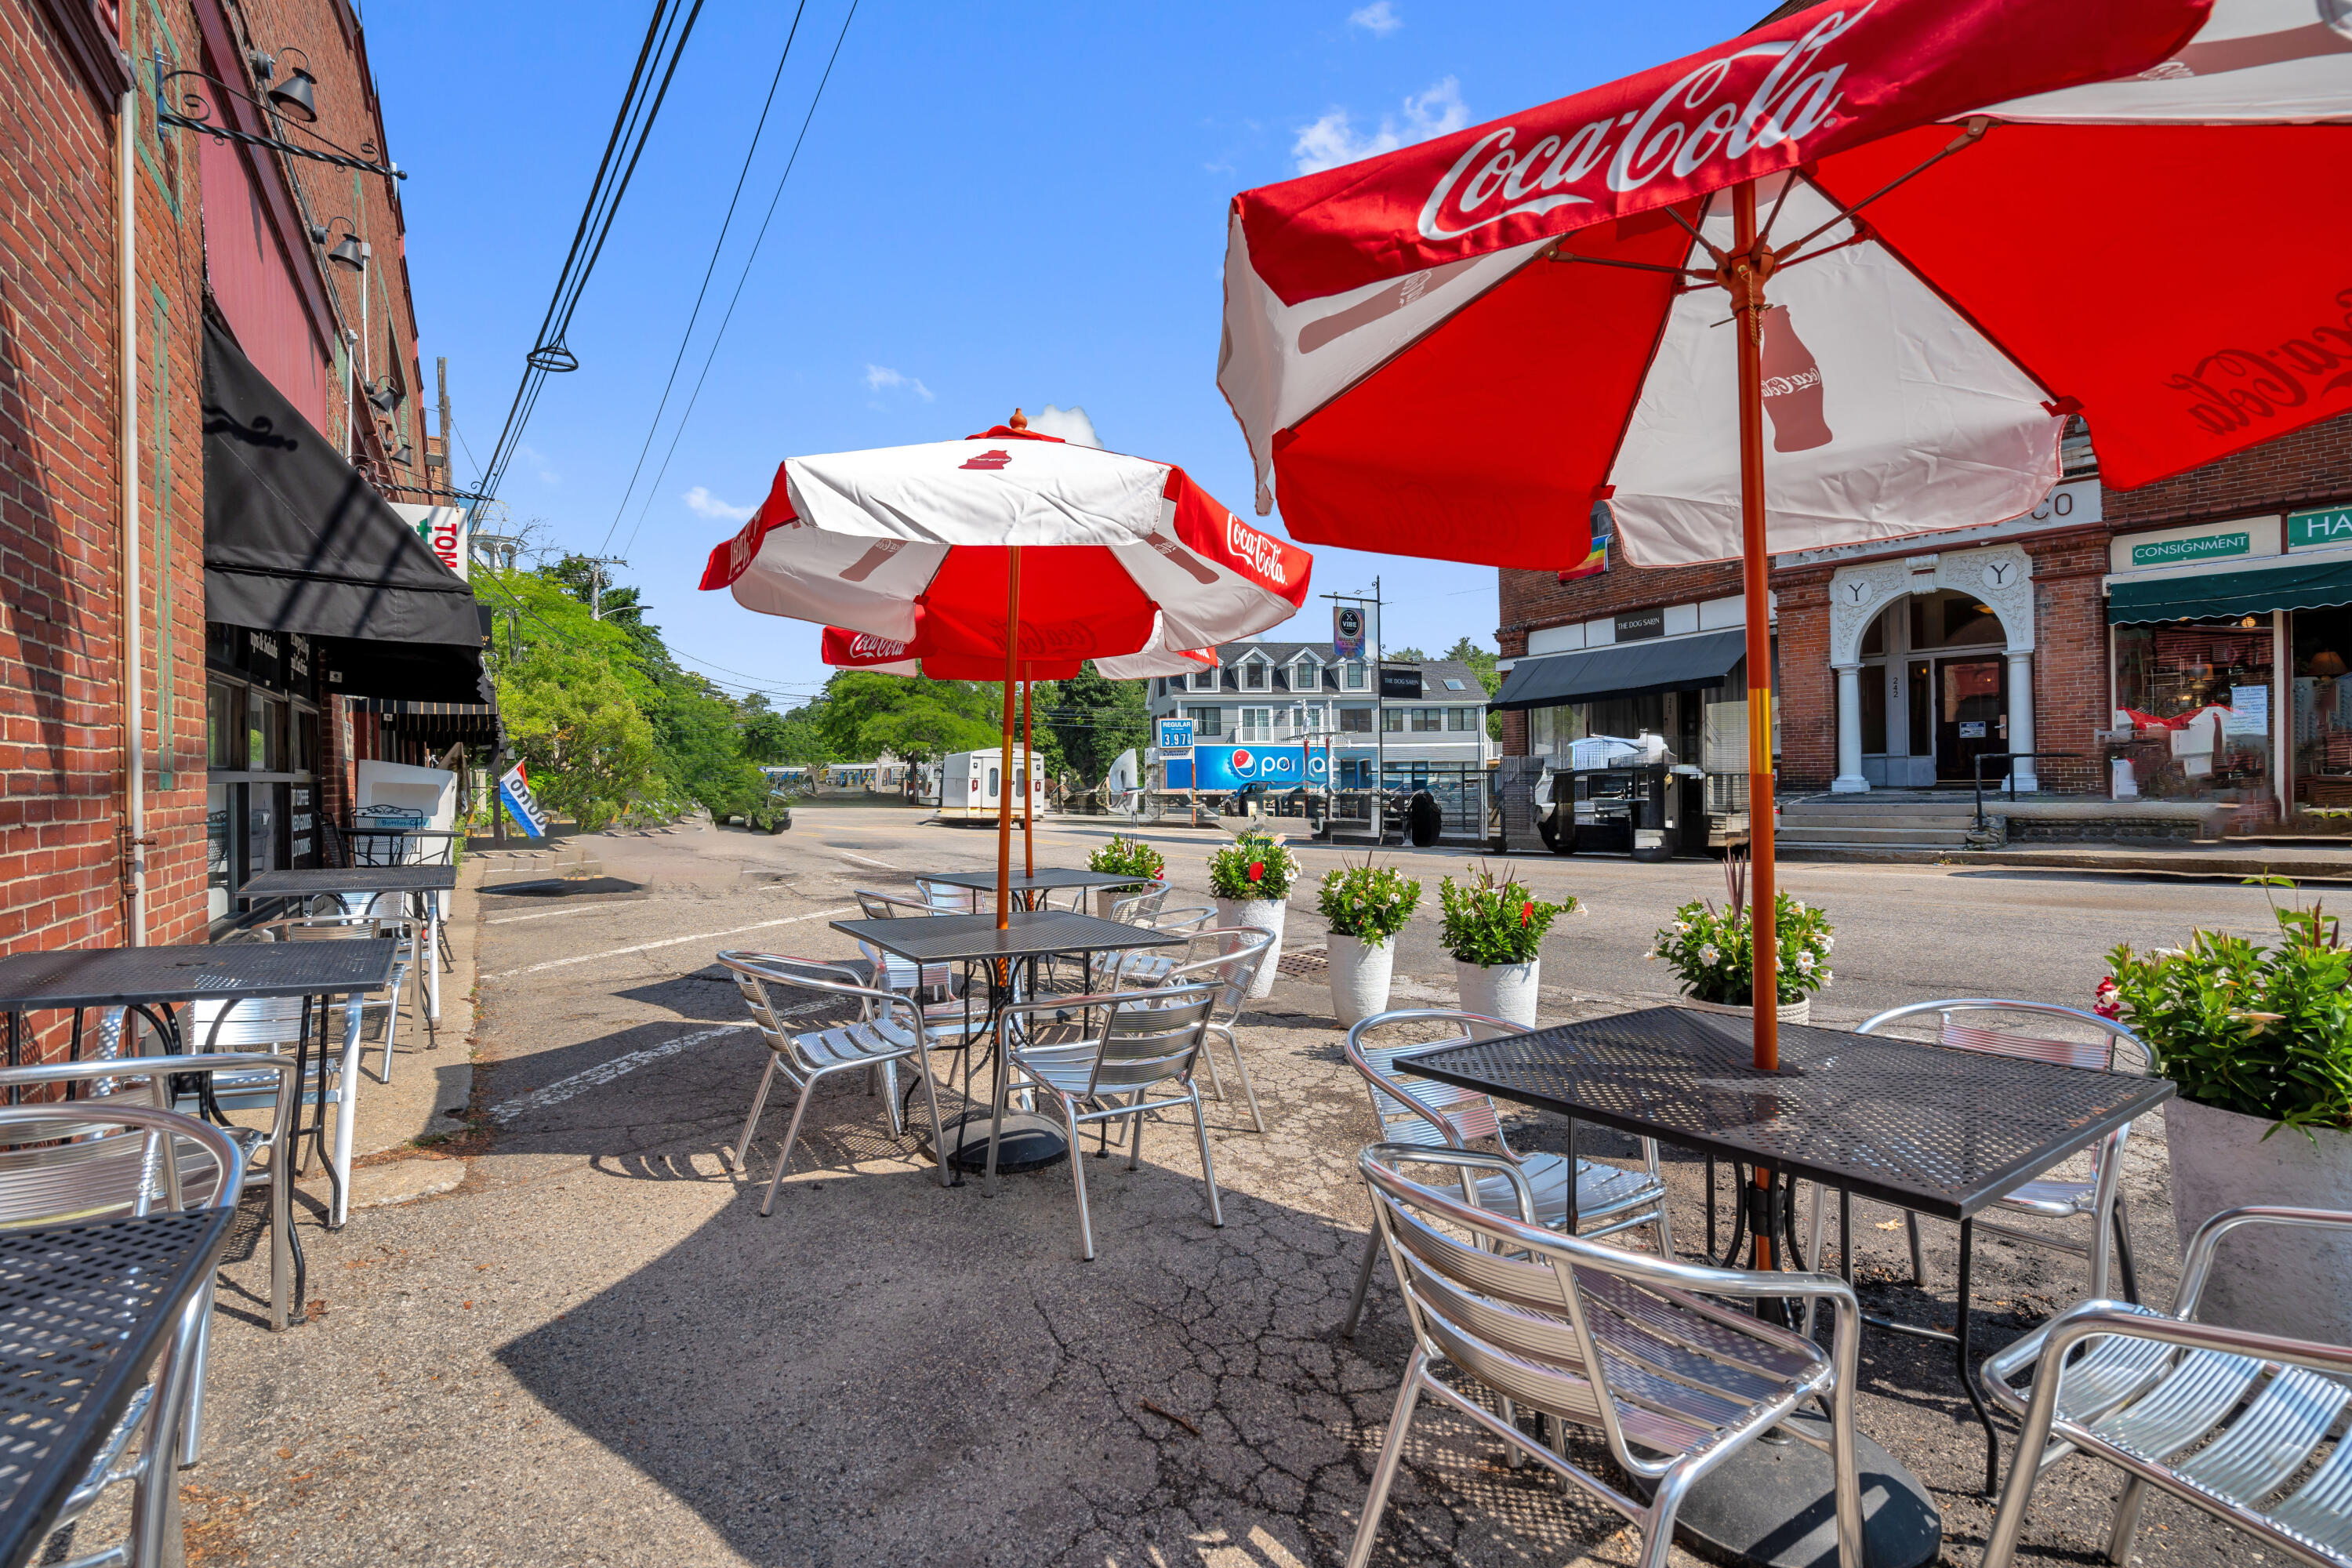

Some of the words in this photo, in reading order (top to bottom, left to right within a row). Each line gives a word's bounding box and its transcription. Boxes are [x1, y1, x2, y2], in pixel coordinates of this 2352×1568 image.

[1417, 0, 1877, 240] Coca-Cola
[1227, 512, 1288, 585] Coca-Cola
[2135, 536, 2247, 558] CONSIGNMENT
[1990, 564, 2009, 584] Y
[1848, 583, 1864, 601] Y
[1618, 622, 1628, 630] THE
[1629, 619, 1642, 628] DOG
